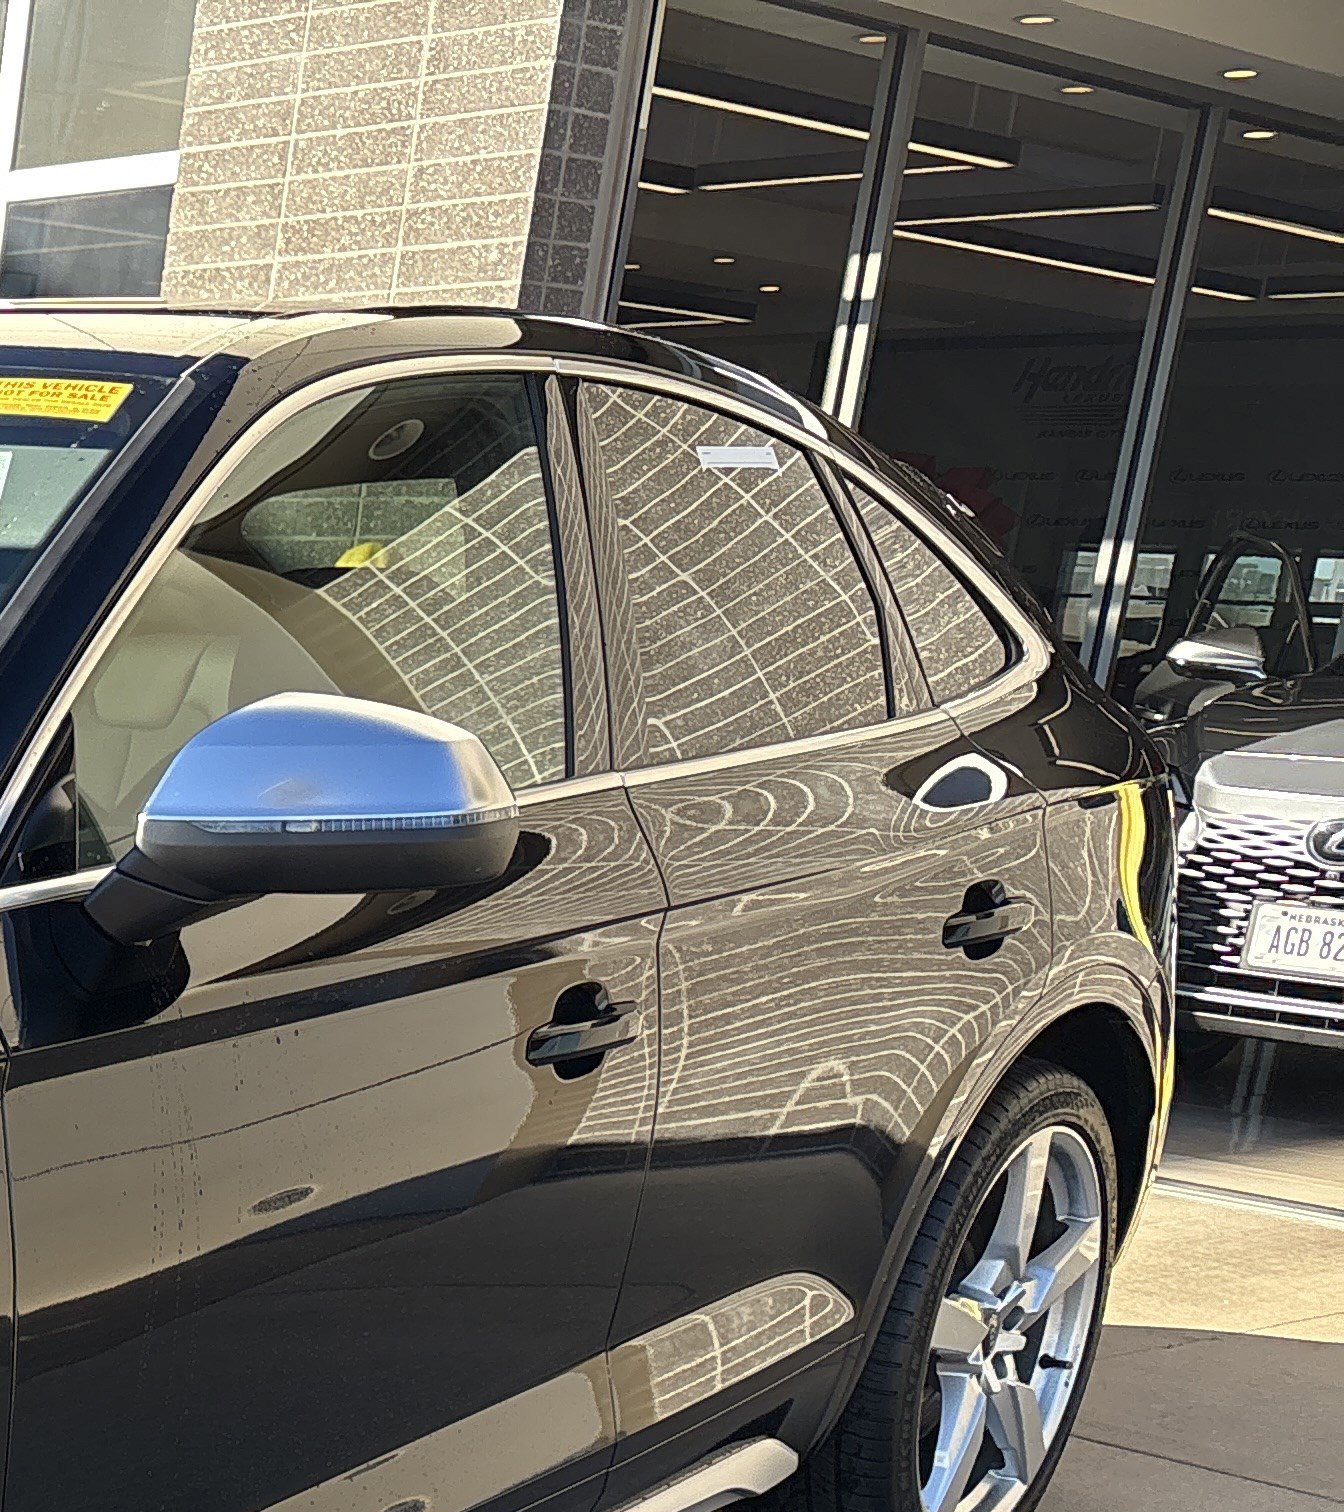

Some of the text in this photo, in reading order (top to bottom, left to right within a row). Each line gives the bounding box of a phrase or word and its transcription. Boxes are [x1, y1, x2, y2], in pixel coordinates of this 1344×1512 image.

[42, 382, 123, 395] VEHICLE
[28, 390, 64, 399] FOR
[67, 392, 112, 403] SALE
[1268, 925, 1344, 961] AGB 82
